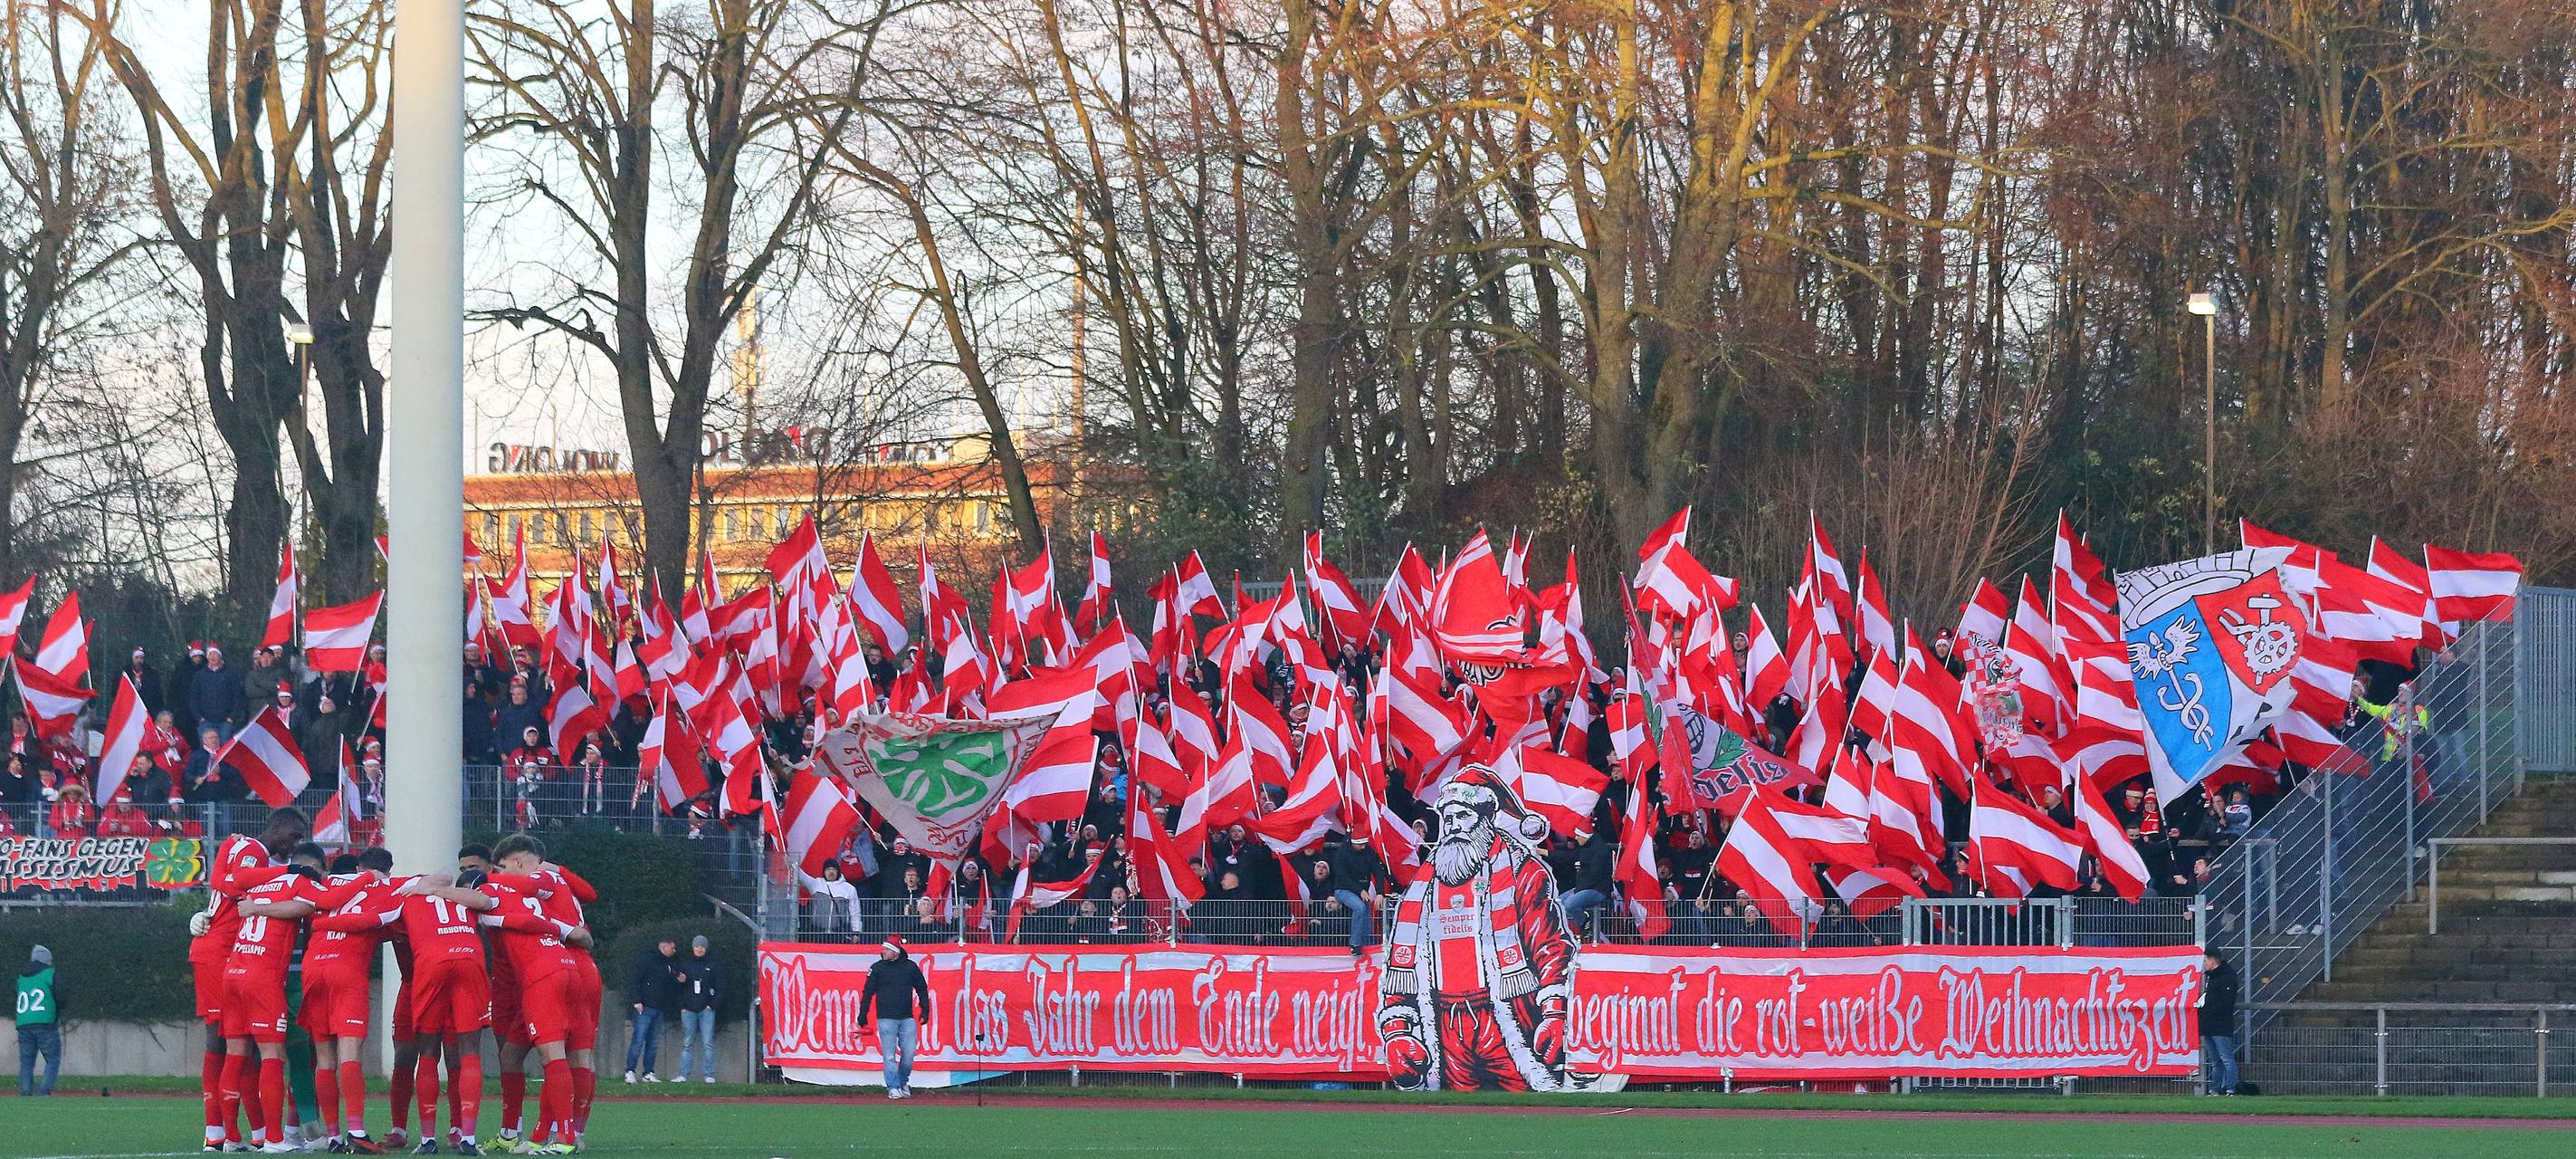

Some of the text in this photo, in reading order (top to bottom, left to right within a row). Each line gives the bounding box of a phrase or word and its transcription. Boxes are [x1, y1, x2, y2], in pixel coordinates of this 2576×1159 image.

[78, 838, 150, 857] GEGEN
[1439, 914, 1474, 924] Semper
[1443, 924, 1473, 934] fidelis
[16, 988, 46, 1014] 02
[761, 953, 863, 1054] Wenn
[954, 957, 1009, 1053] das
[1023, 956, 1102, 1053] Jahr
[1113, 955, 1178, 1053] dem
[1192, 956, 1280, 1054] Ende
[1567, 969, 1688, 1071] beginnt
[1695, 969, 1743, 1053] die
[1756, 967, 1924, 1054] rot-weiße
[1939, 966, 2197, 1073] Weihnachtszeit
